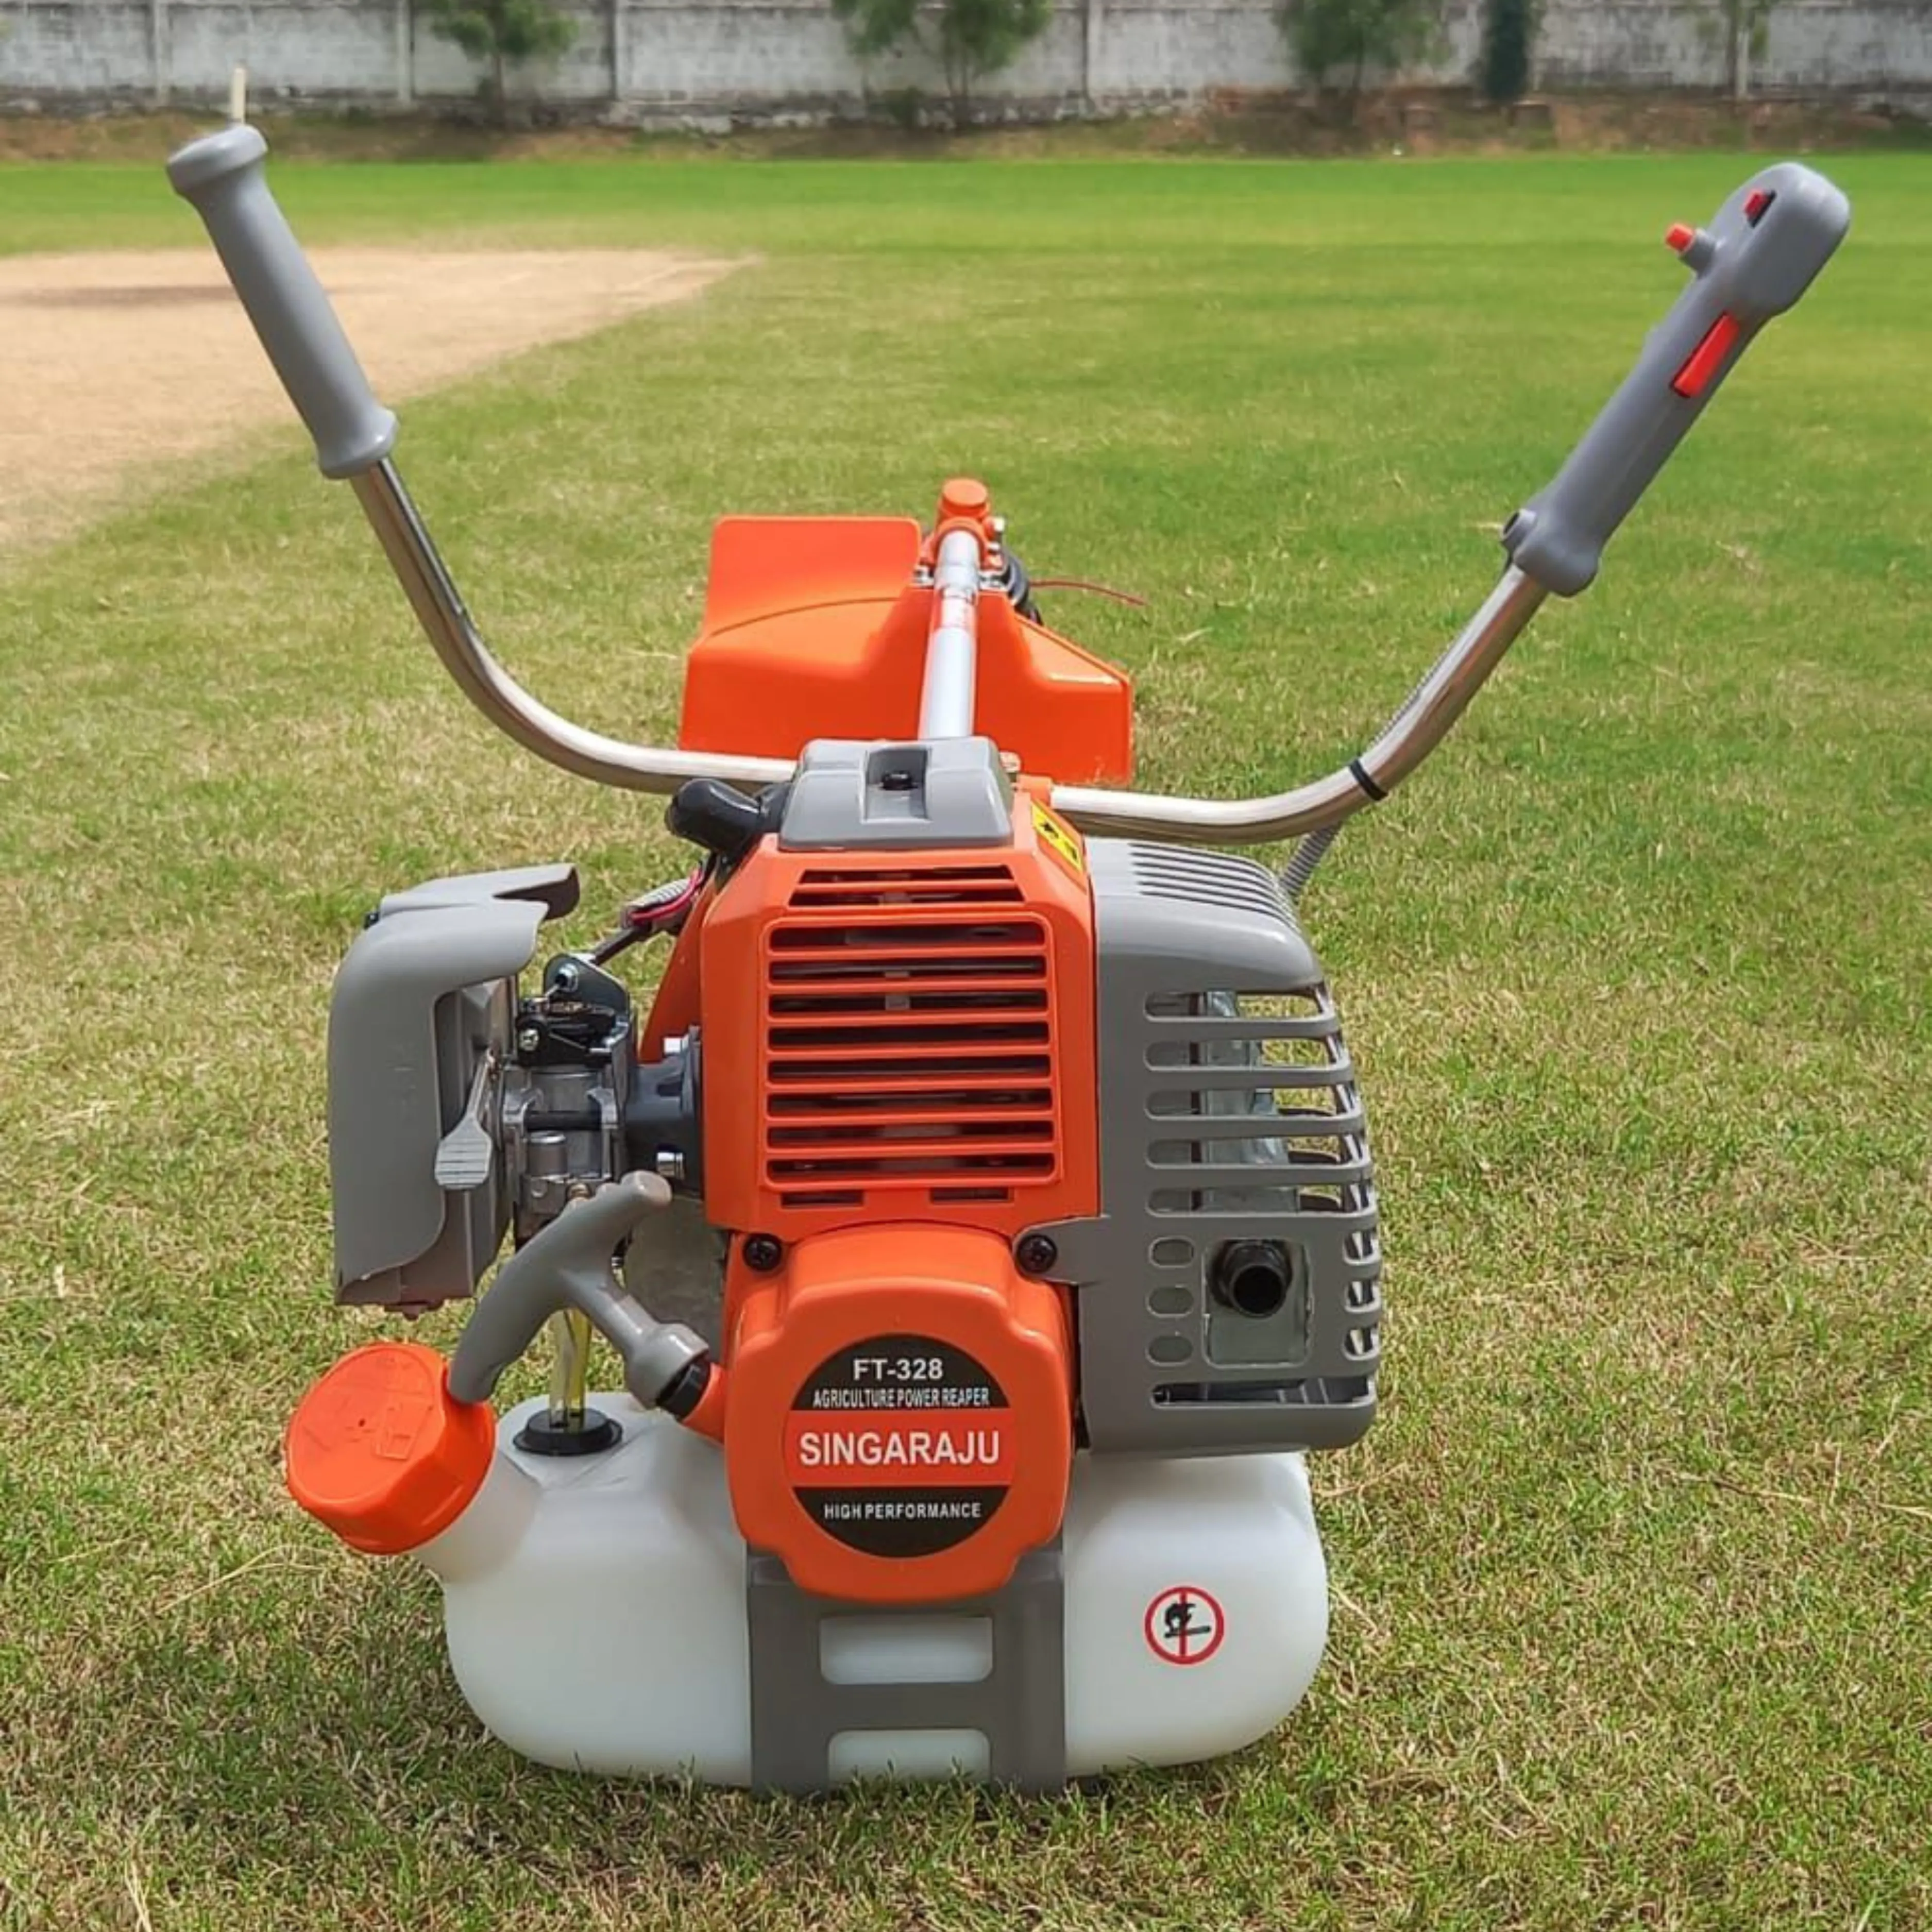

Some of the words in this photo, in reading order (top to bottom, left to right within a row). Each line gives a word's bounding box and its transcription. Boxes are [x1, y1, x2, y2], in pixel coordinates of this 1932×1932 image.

[853, 1358, 943, 1381] FT-328
[813, 1389, 895, 1408] AGRICULTURE
[897, 1388, 939, 1407] POWER
[941, 1387, 990, 1405] REAPER
[800, 1431, 999, 1465] SINGARAJU
[824, 1503, 861, 1520] HIGH
[865, 1502, 982, 1520] PERFORMANCE
